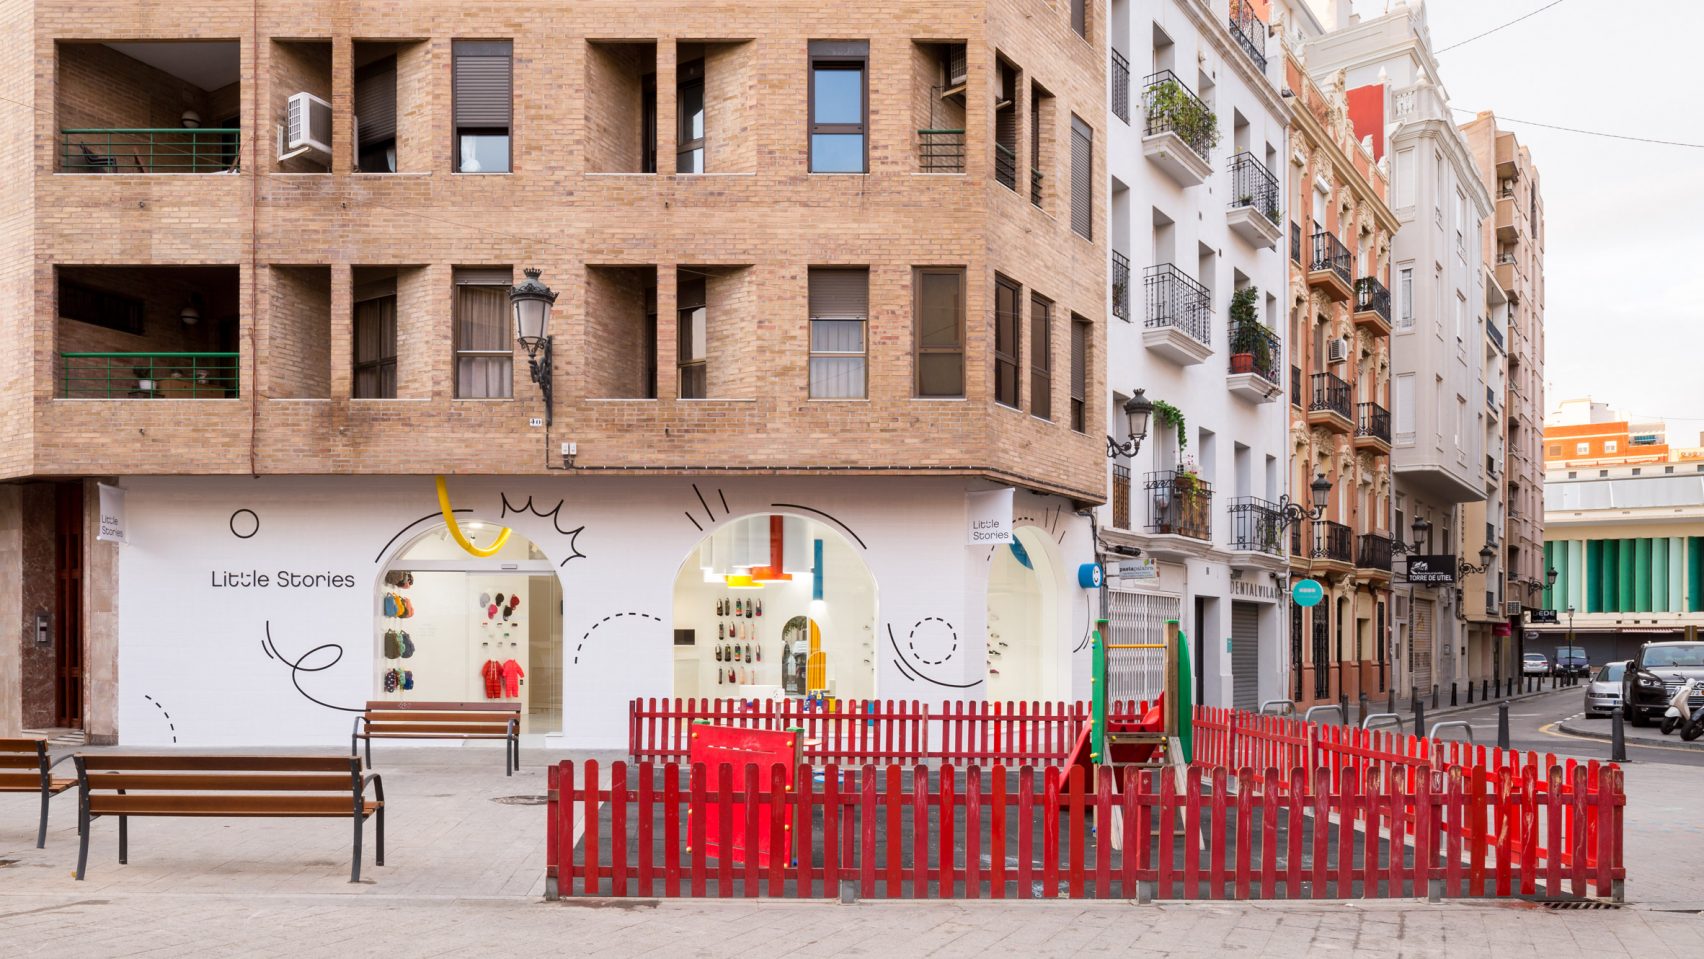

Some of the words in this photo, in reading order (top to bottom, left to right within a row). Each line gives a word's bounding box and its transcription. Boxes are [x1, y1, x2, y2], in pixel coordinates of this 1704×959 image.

[972, 519, 1000, 530] Little
[101, 525, 123, 538] Stories
[973, 530, 1009, 541] Stories
[211, 569, 270, 588] Little
[277, 570, 355, 588] Stories
